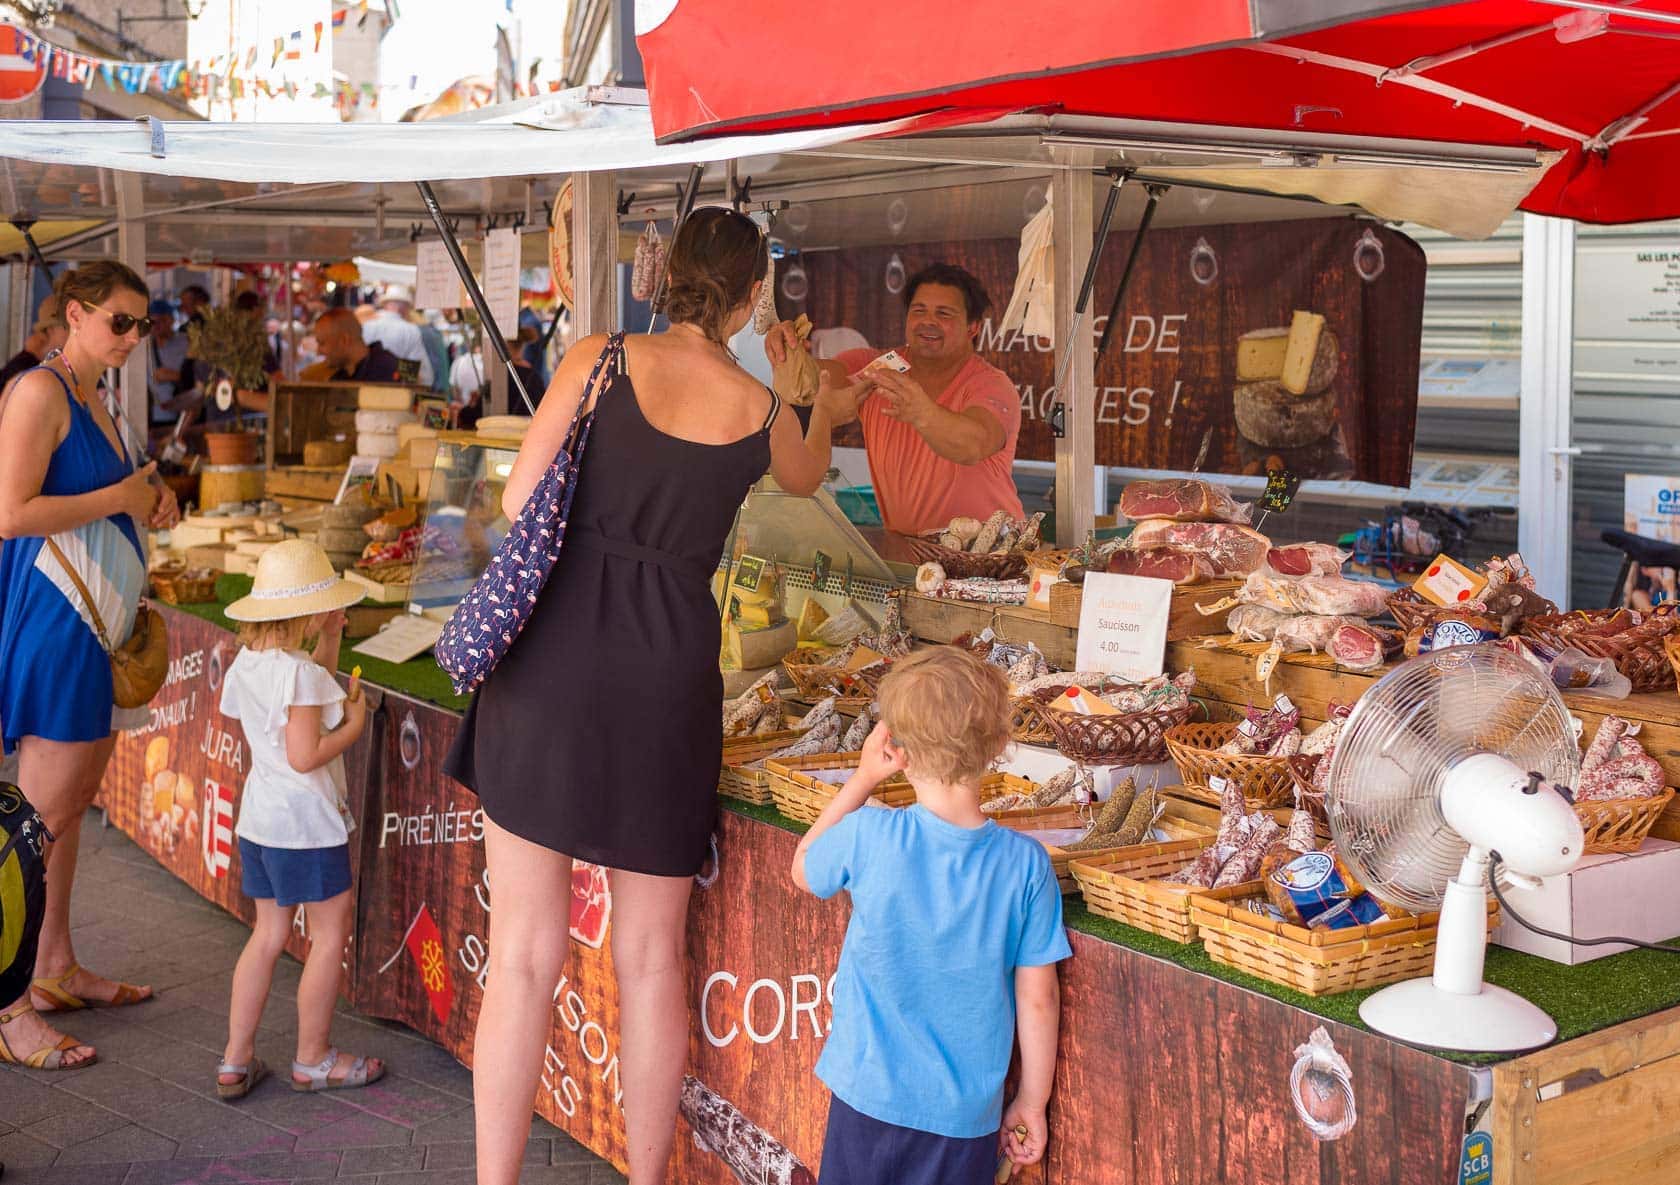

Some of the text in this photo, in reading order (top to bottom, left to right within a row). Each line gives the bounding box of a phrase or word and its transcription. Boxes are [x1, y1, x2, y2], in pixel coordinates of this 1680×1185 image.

[1123, 314, 1187, 354] DE
[1097, 617, 1140, 632] Saucisson
[200, 719, 242, 773] JURA
[379, 801, 485, 848] PYRÉNÉES
[1463, 1155, 1489, 1177] SCB
